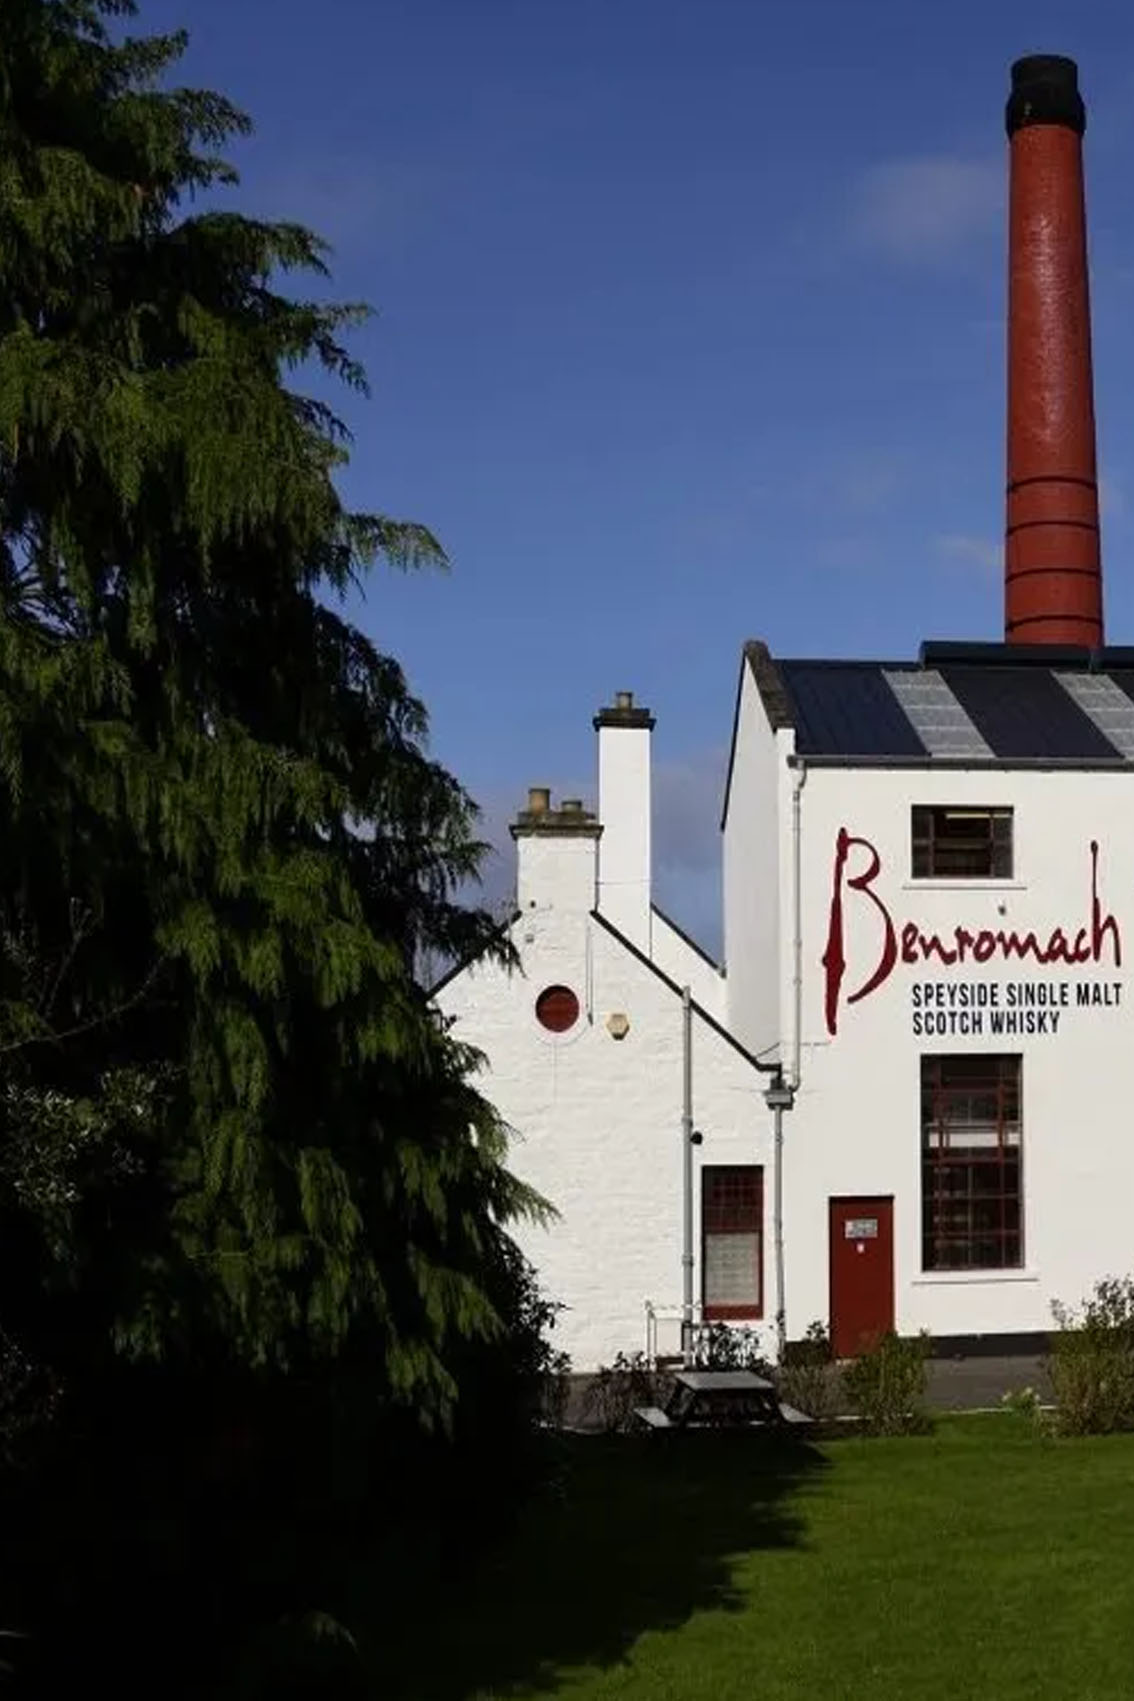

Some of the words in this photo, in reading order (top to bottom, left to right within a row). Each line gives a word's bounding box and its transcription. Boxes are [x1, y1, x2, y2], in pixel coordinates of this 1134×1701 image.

[822, 827, 1121, 1035] Benromach
[911, 982, 999, 1007] SPEYSIDE
[1006, 982, 1069, 1007] SINGLE
[1076, 982, 1122, 1006] MALT
[912, 1010, 983, 1036] SCOTCH
[990, 1010, 1061, 1035] WHISKY
